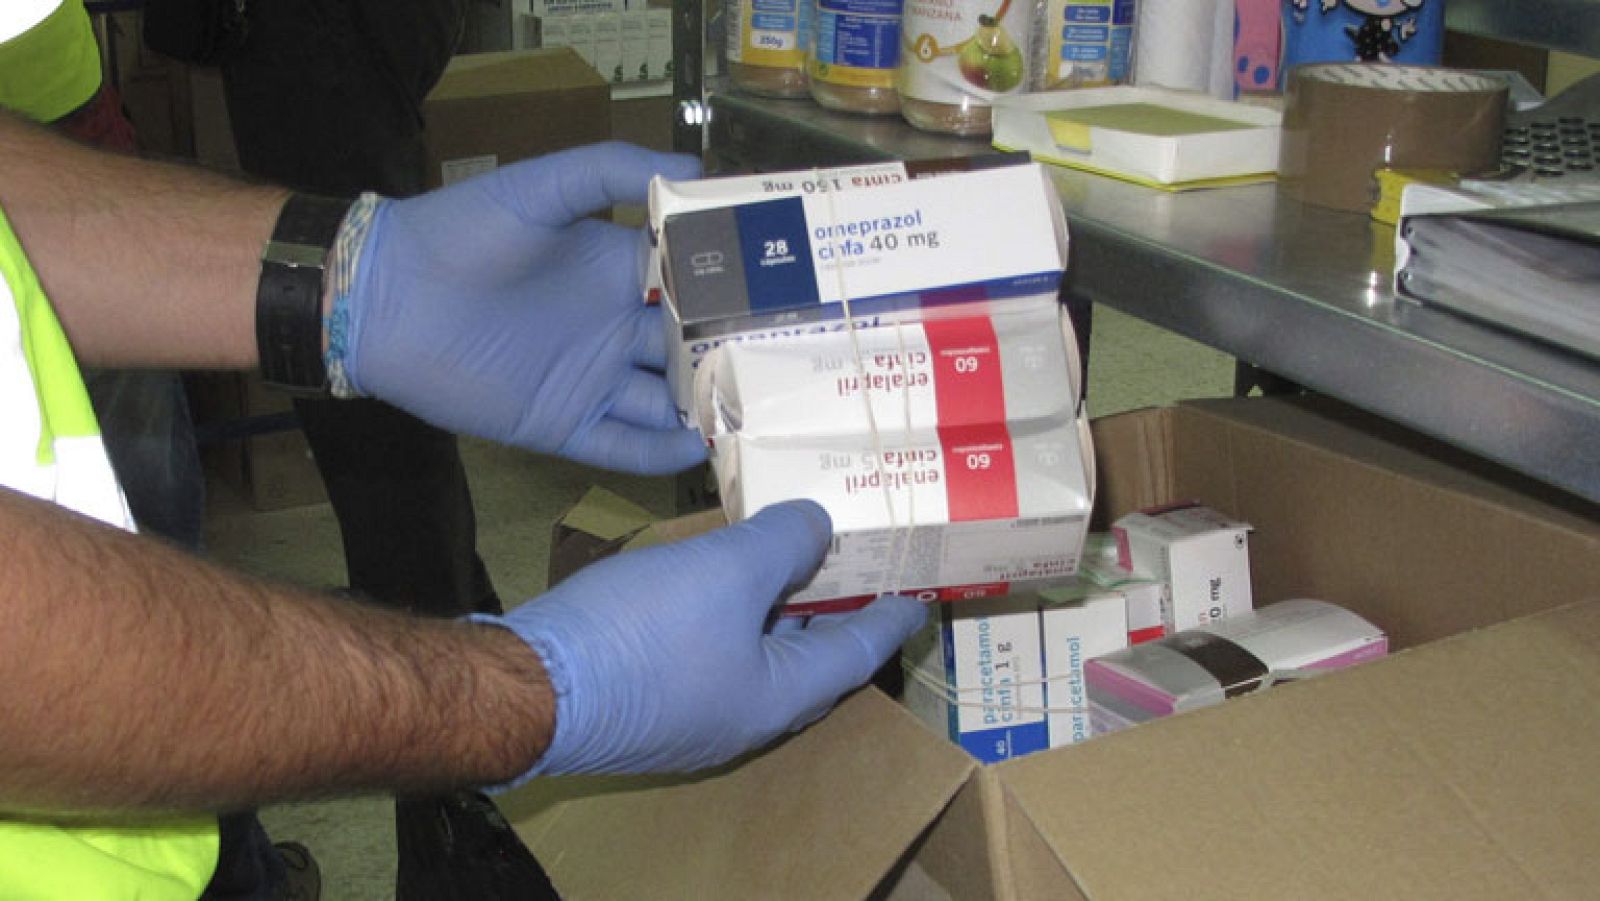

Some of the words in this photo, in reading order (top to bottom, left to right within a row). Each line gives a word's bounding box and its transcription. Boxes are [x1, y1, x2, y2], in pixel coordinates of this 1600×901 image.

[814, 208, 923, 241] omeprazol
[763, 239, 789, 257] 28
[817, 239, 865, 261] cinfa
[869, 233, 900, 251] 40
[906, 230, 941, 249] mg
[954, 356, 979, 374] 60
[883, 449, 938, 468] cinfa
[965, 452, 992, 470] 60
[1210, 606, 1222, 618] 0
